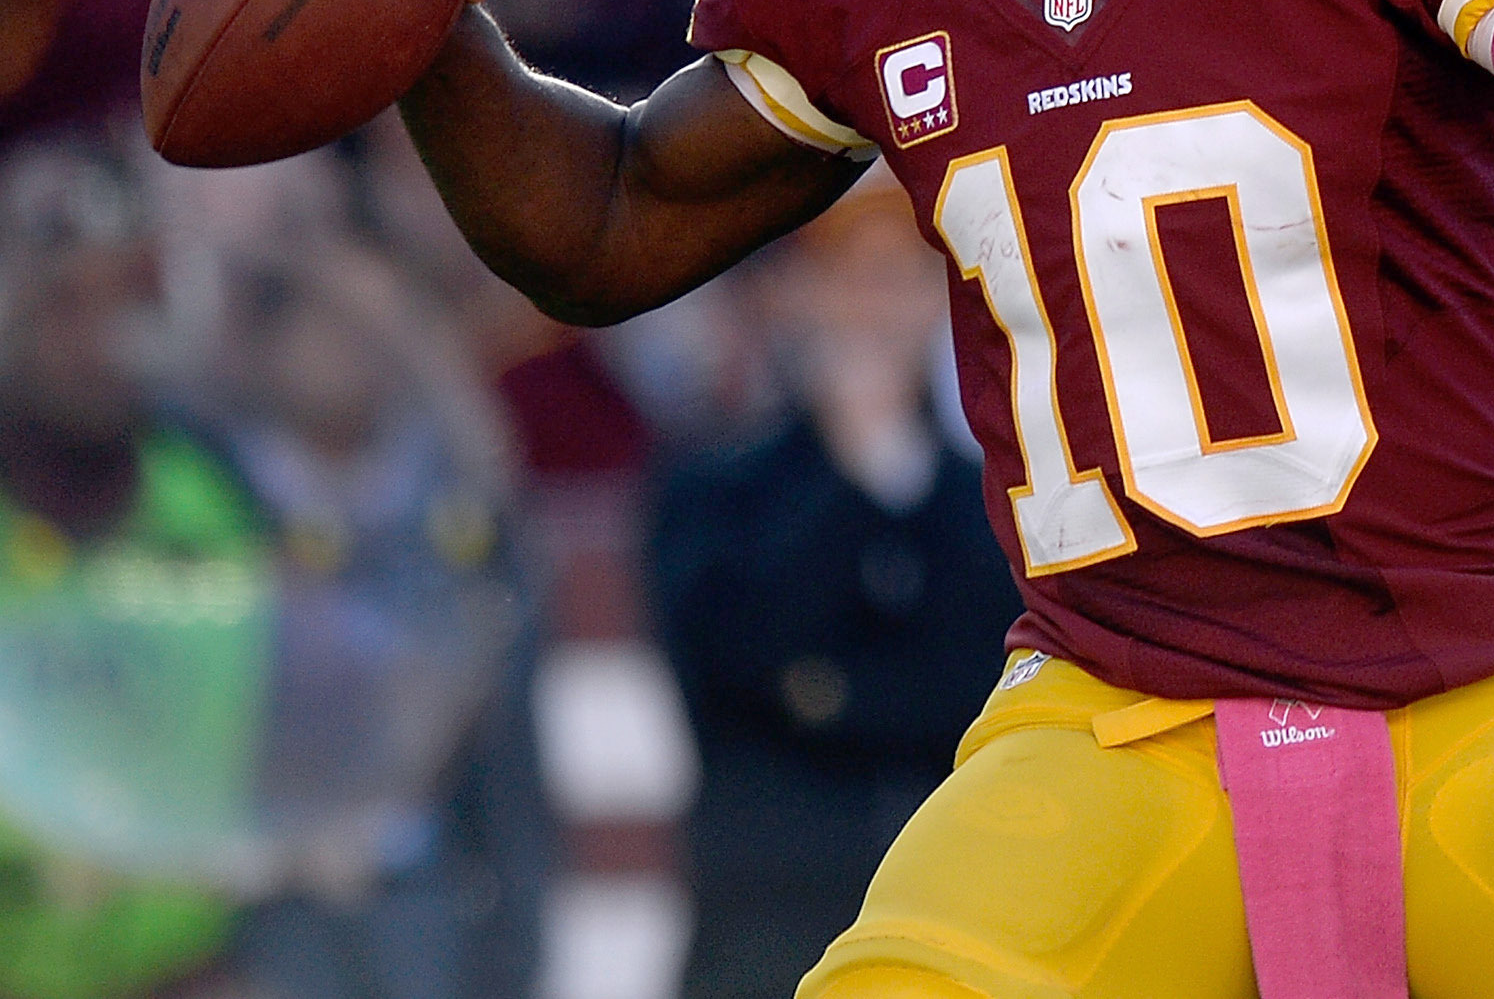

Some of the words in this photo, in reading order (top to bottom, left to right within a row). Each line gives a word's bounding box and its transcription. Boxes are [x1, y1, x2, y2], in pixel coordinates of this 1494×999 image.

[883, 41, 946, 119] C
[1027, 72, 1133, 115] REDSKINS
[933, 99, 1379, 579] 10
[1260, 725, 1328, 748] Wilson
